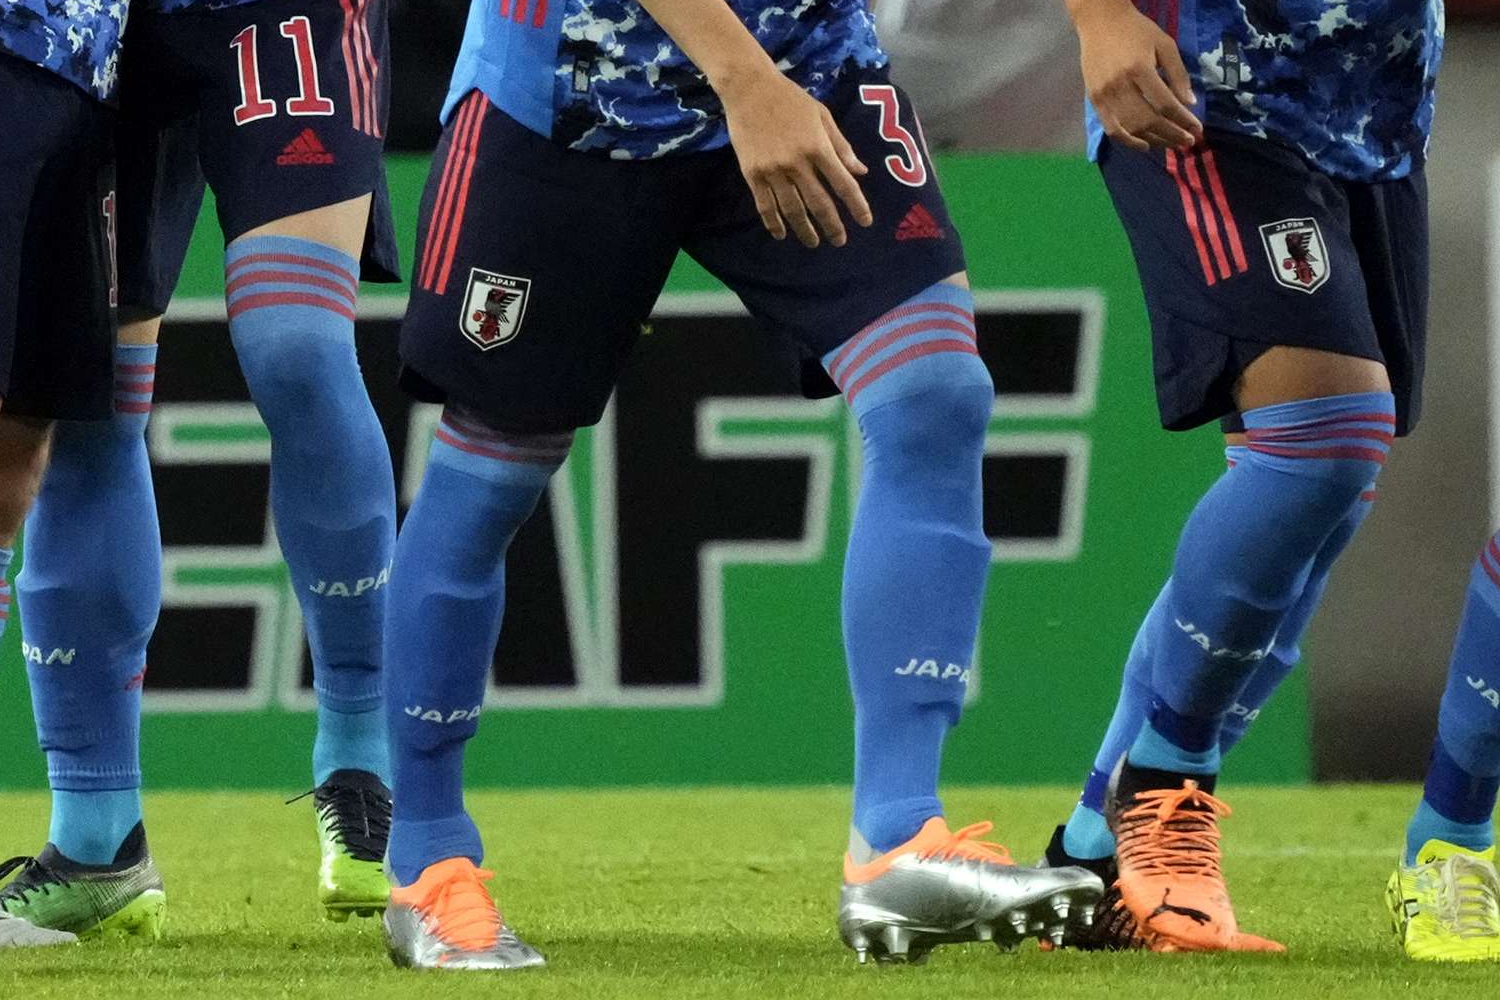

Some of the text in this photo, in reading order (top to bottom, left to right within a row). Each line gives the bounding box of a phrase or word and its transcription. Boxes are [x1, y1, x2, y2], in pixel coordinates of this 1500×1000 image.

[229, 15, 335, 126] 11
[859, 84, 927, 187] 3
[485, 275, 517, 287] JAPAN
[308, 557, 394, 597] JAPA
[404, 705, 485, 724] JAPA
